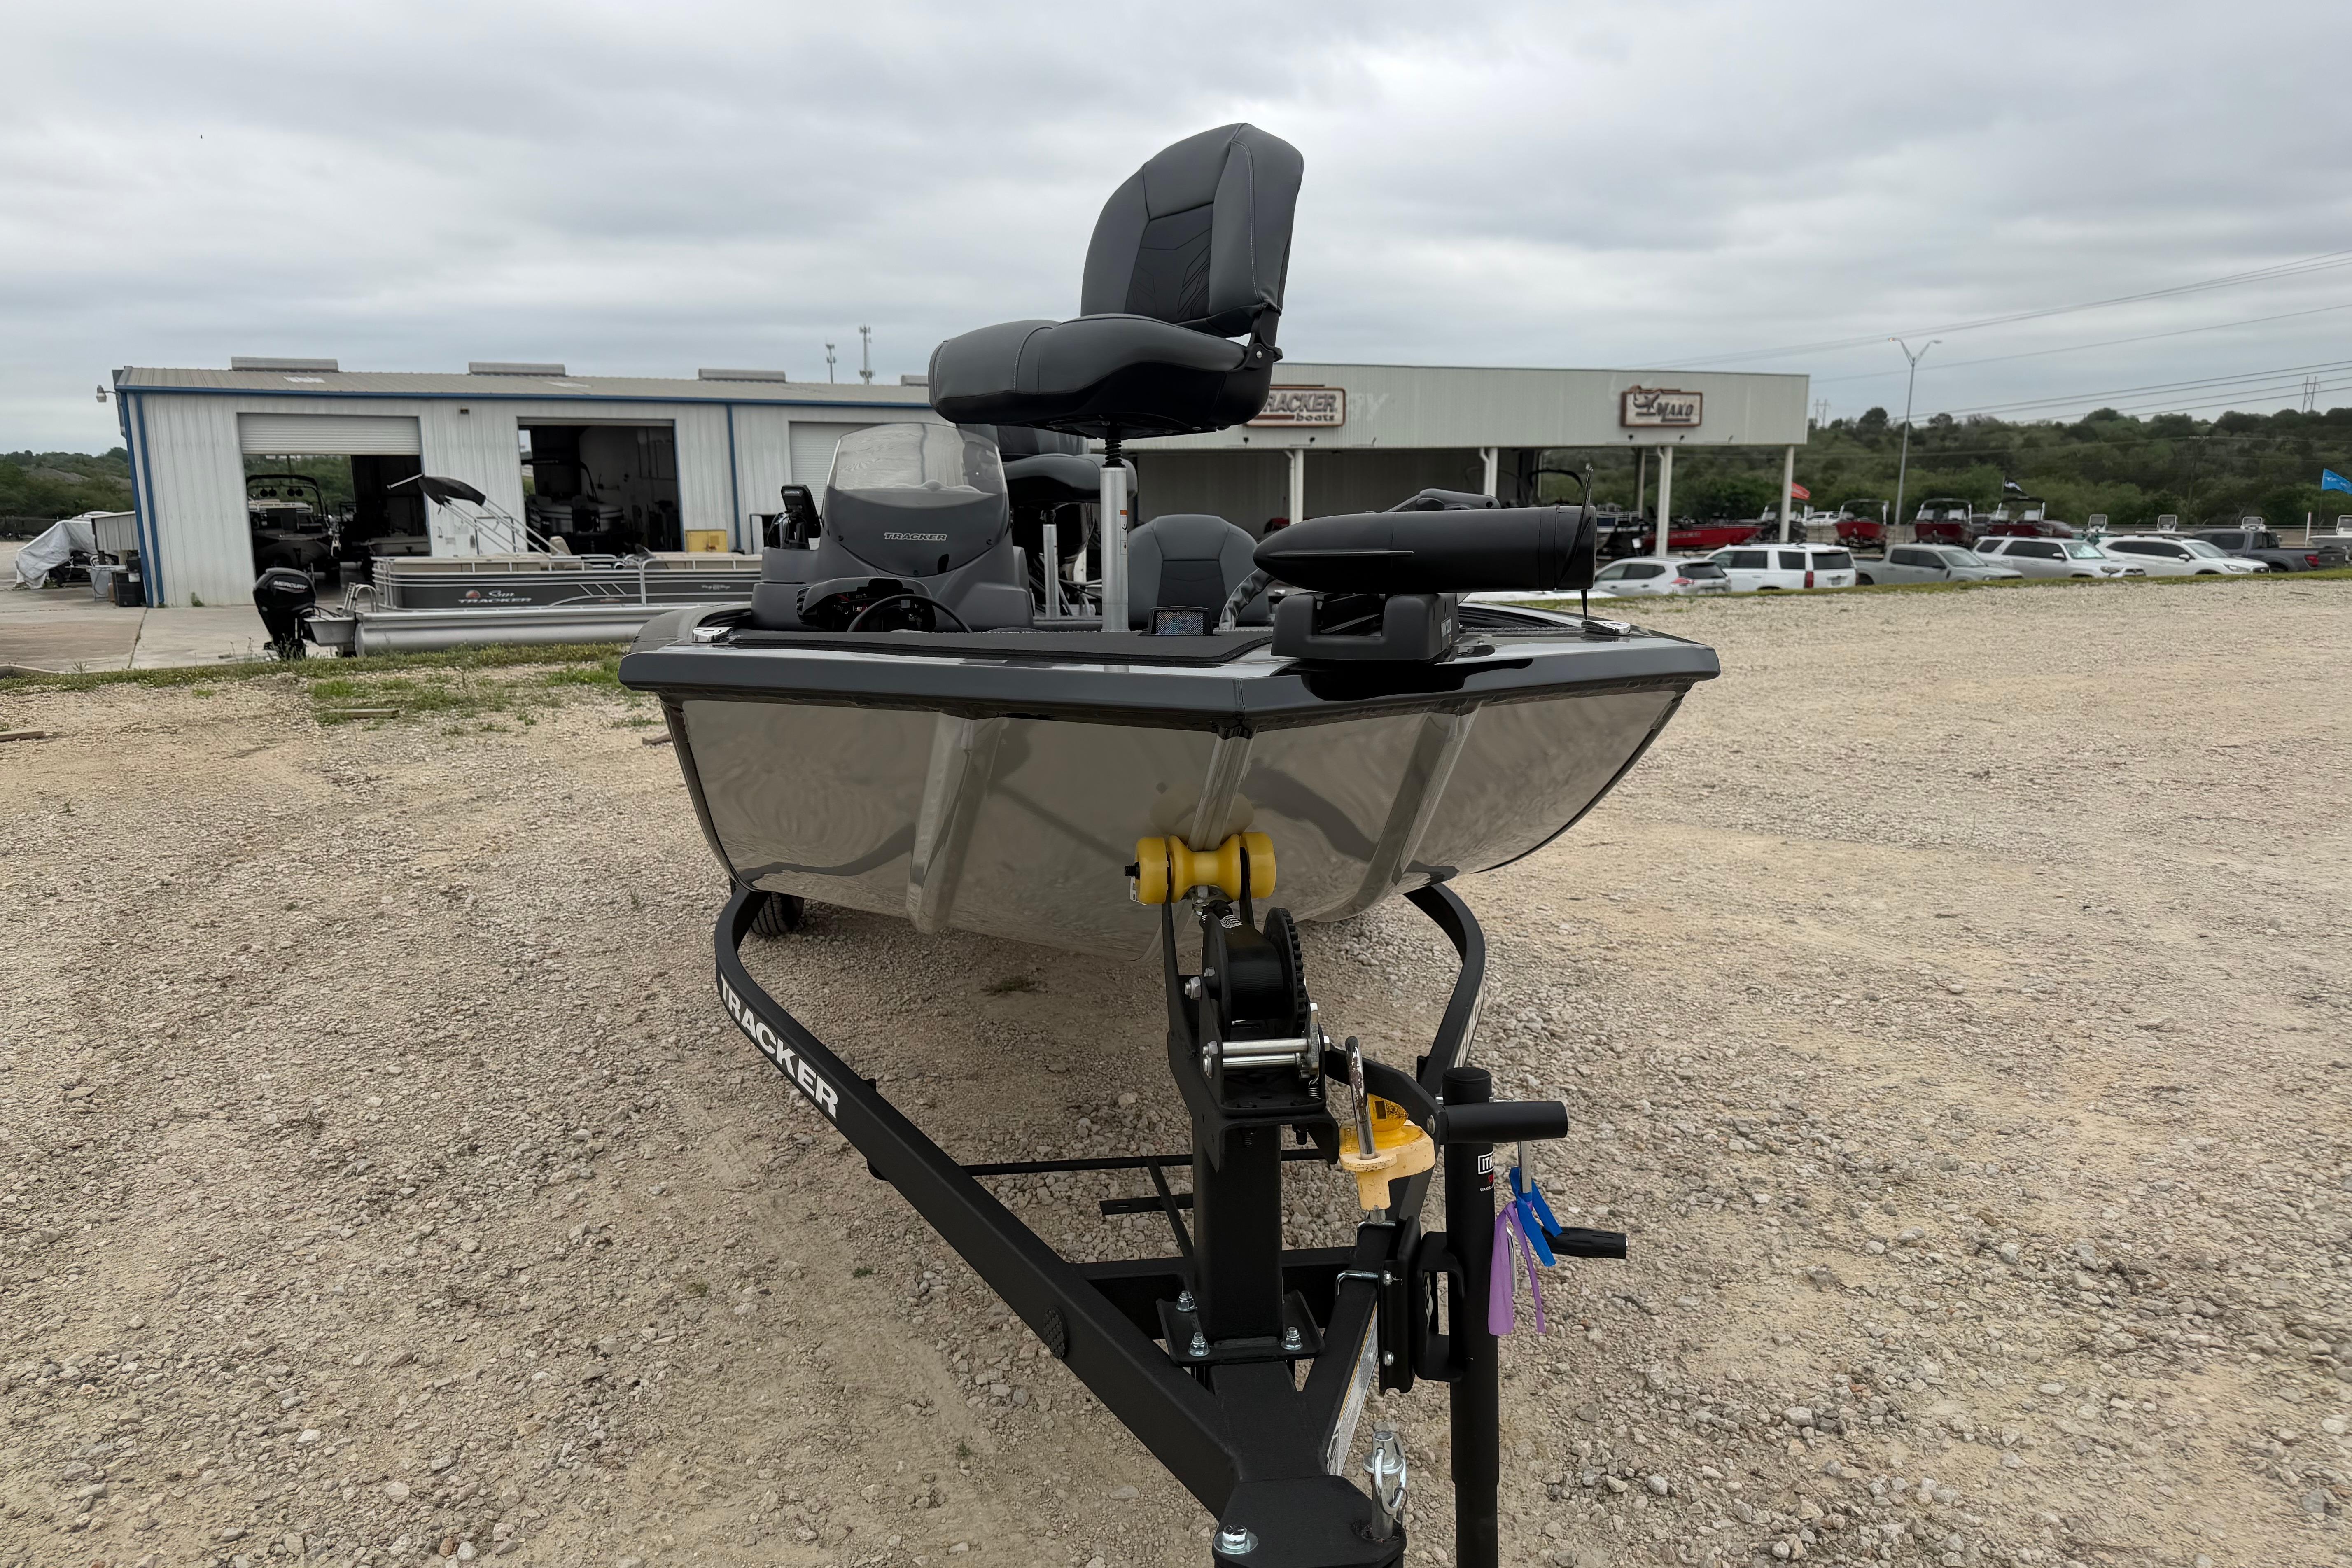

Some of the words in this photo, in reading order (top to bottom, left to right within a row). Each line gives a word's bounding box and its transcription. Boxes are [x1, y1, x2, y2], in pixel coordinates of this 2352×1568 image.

[1263, 393, 1337, 413] RACKER
[1656, 402, 1694, 423] MAKO
[1296, 413, 1335, 422] boats
[884, 532, 947, 541] TRACKER
[720, 971, 838, 1120] TRACKER
